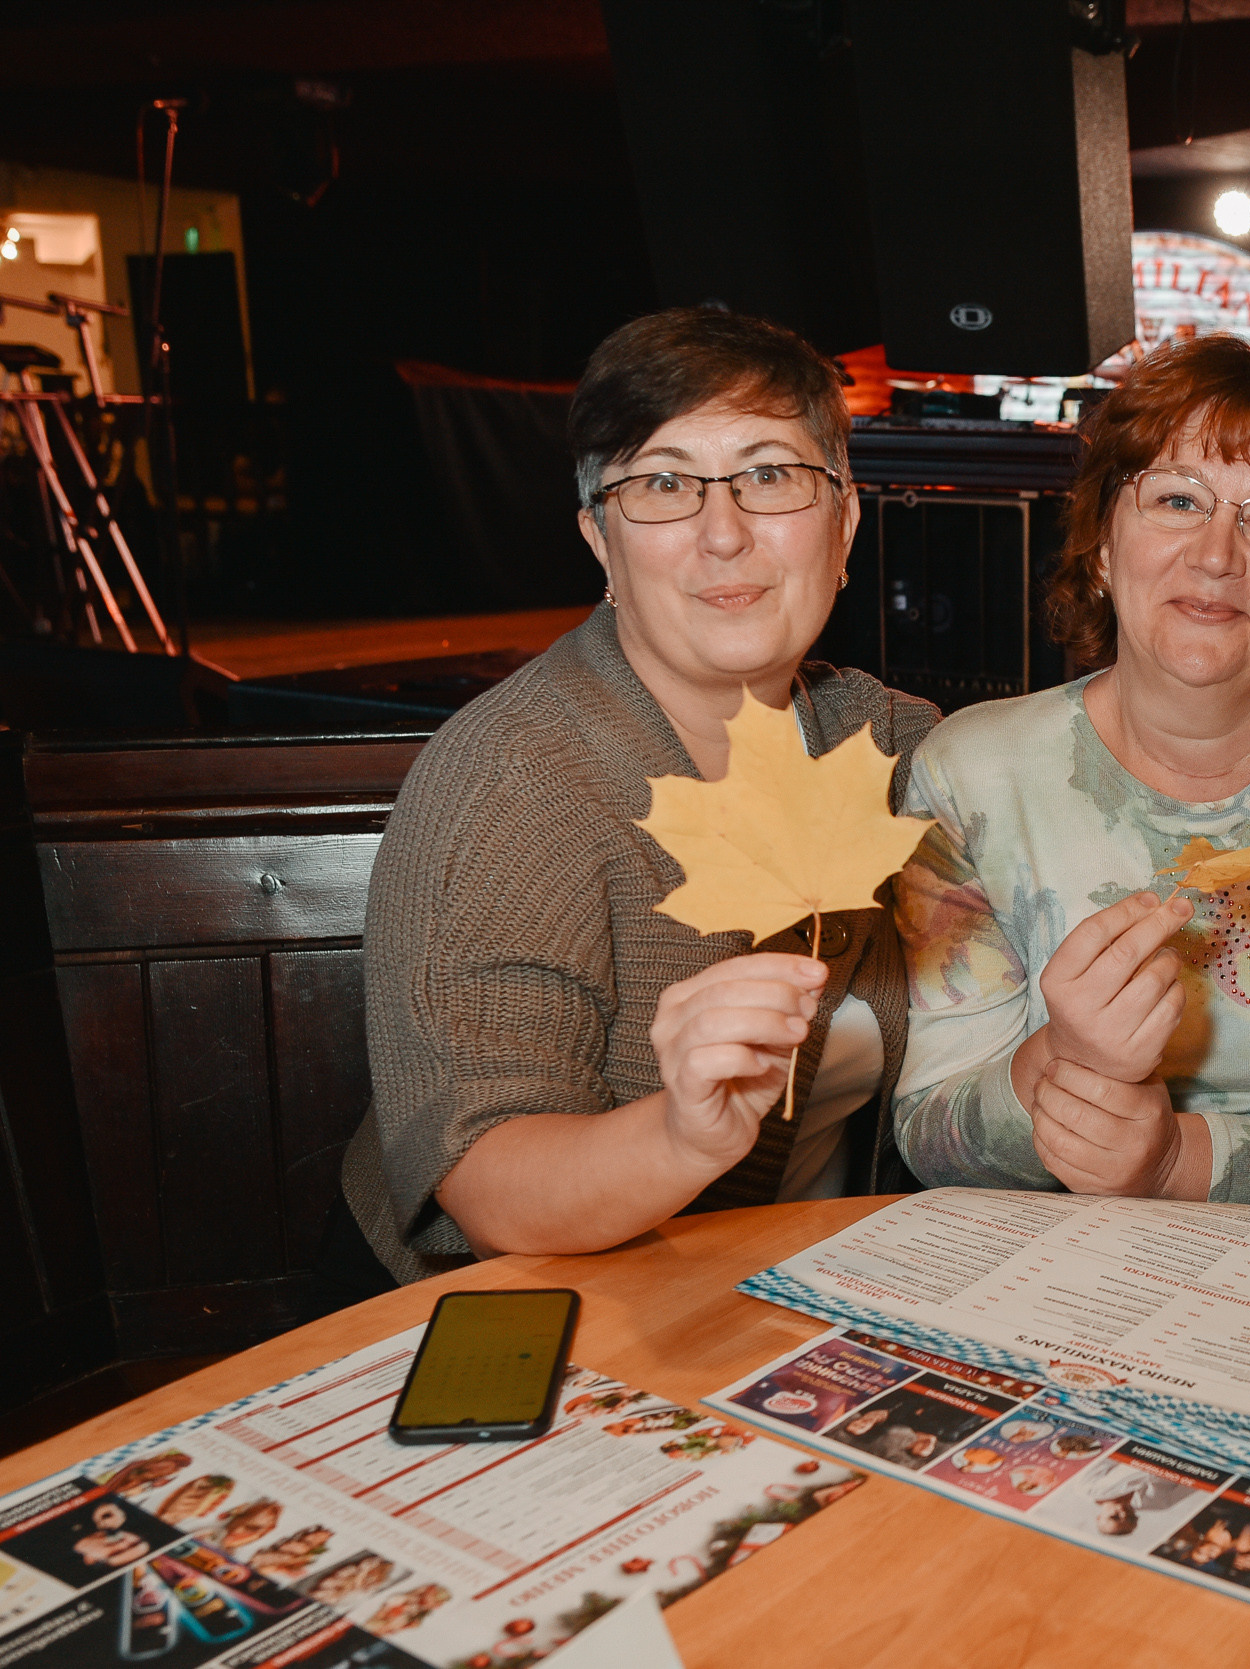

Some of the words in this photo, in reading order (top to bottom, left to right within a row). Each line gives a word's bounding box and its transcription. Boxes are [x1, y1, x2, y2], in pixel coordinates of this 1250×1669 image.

[910, 1202, 974, 1221] СКОВОРОДКИ
[972, 1219, 1038, 1238] АЛЬПИЙСКИЕ
[1165, 1223, 1227, 1241] КОМПАНИЙ
[1226, 1239, 1250, 1247] ДЛЯ
[814, 1267, 905, 1299] МОРЕПРОДУКТОВ
[1120, 1266, 1182, 1286] КОЛБАСКИ
[833, 1280, 885, 1299] ЗАКУСКИ
[838, 1349, 882, 1370] НОЯБРЯ
[1012, 1335, 1137, 1371] MAXIMILIAN'S
[1108, 1351, 1162, 1367] ЗАКУСКИ
[791, 1357, 882, 1396] ВЕЧЕРИНКА
[1136, 1368, 1196, 1387] МЕНЮ
[941, 1381, 988, 1402] PLAZMA
[1130, 1445, 1178, 1466] КАШИН
[1174, 1460, 1219, 1480] ПАВЕЛ
